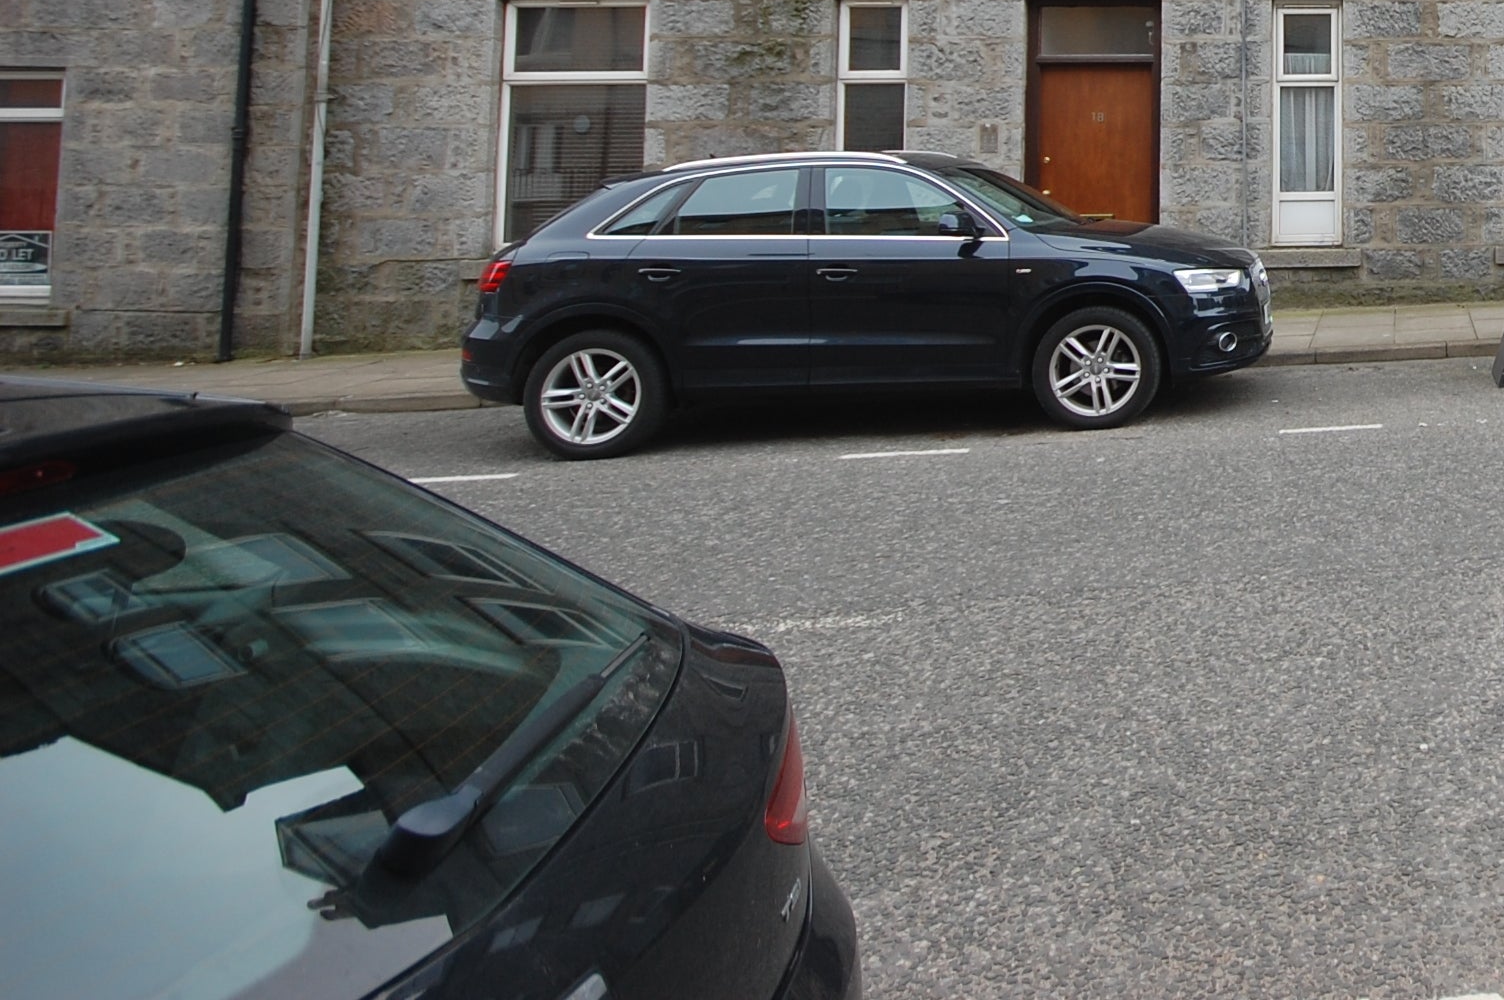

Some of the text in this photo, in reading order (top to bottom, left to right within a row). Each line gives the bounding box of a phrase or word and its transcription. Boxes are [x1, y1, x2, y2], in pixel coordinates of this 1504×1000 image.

[1090, 111, 1104, 122] 18
[0, 248, 34, 260] O LET
